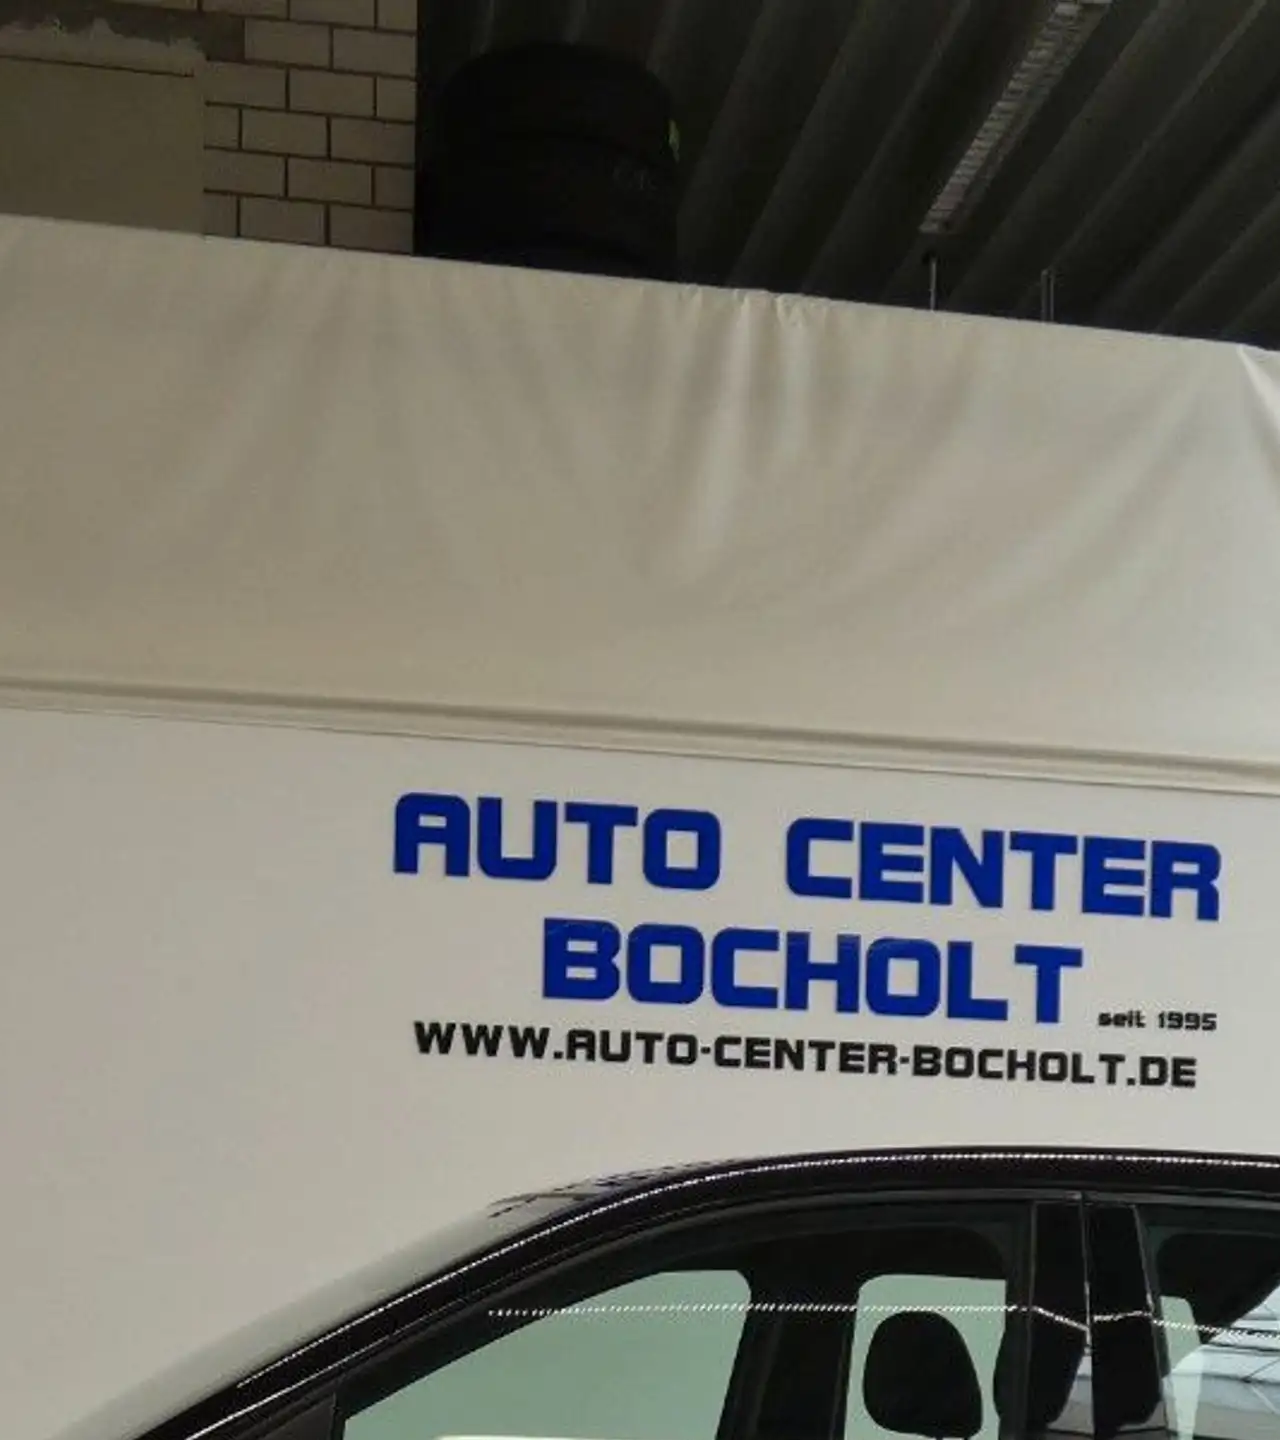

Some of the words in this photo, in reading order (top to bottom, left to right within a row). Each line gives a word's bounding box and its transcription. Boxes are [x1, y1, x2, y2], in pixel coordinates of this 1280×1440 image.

[393, 791, 722, 892] AUTO
[785, 817, 1222, 922] CENTER
[542, 917, 1084, 1024] BOCHOLT
[413, 1020, 1198, 1089] WWW.AUTO-CENTER-BOCHOLT.DE
[1097, 1009, 1147, 1029] seit
[1157, 1010, 1218, 1032] 1995
